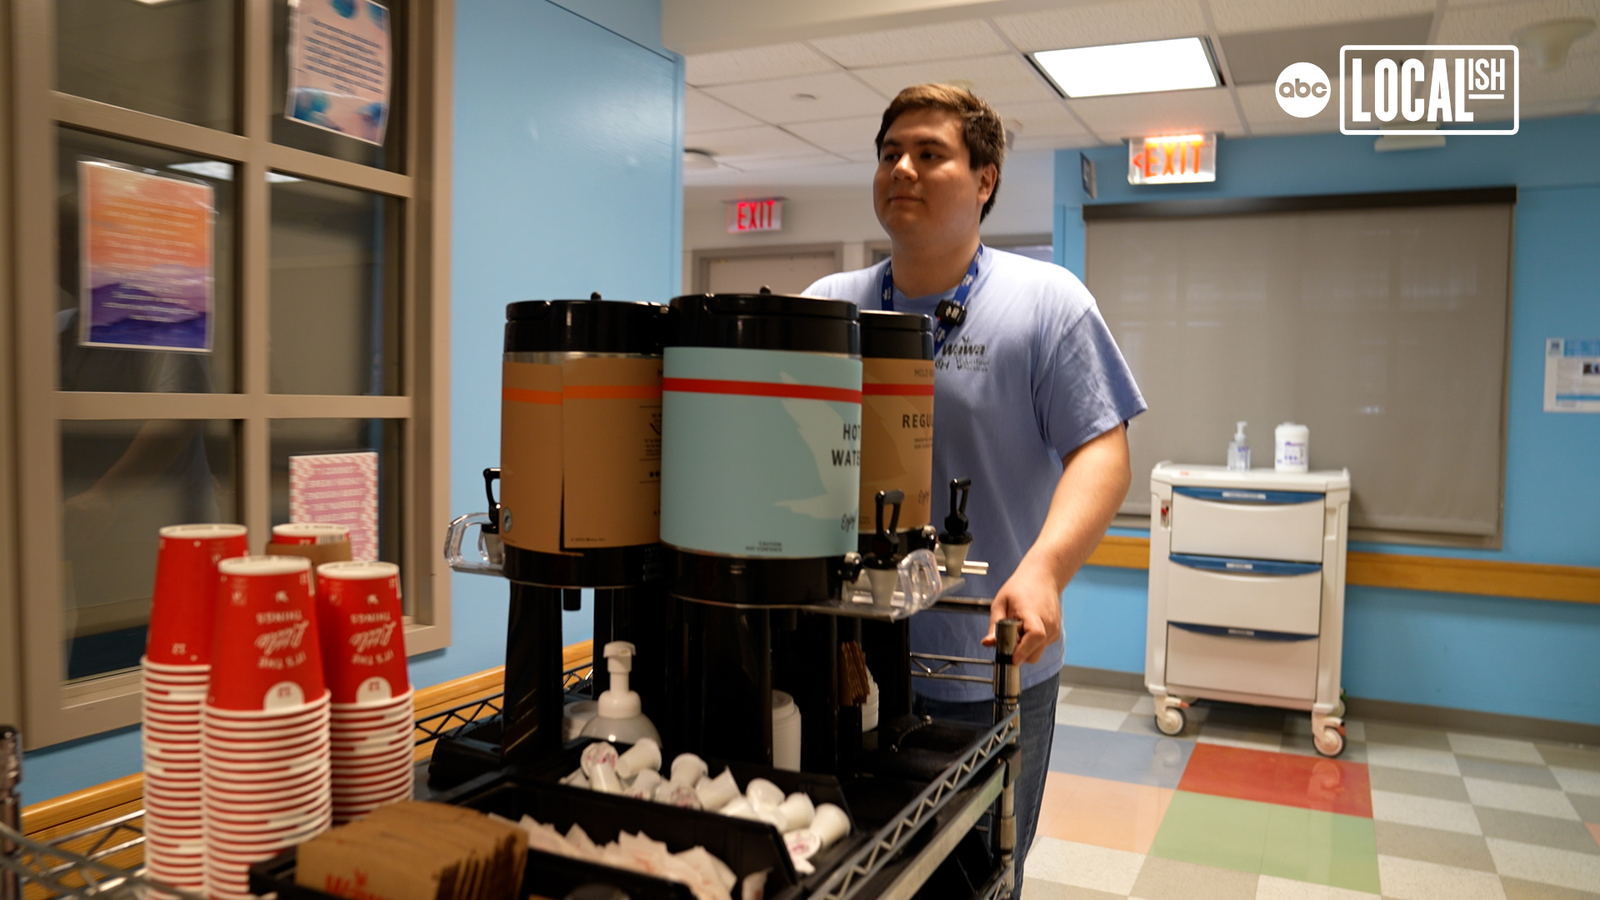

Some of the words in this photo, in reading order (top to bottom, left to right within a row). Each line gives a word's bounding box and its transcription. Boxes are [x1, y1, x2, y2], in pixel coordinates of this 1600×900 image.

[1144, 140, 1205, 177] EXIT
[737, 200, 775, 230] EXIT
[902, 414, 933, 429] REGU
[831, 449, 860, 466] WATE
[255, 610, 303, 625] THINGS
[350, 611, 391, 625] THINGS
